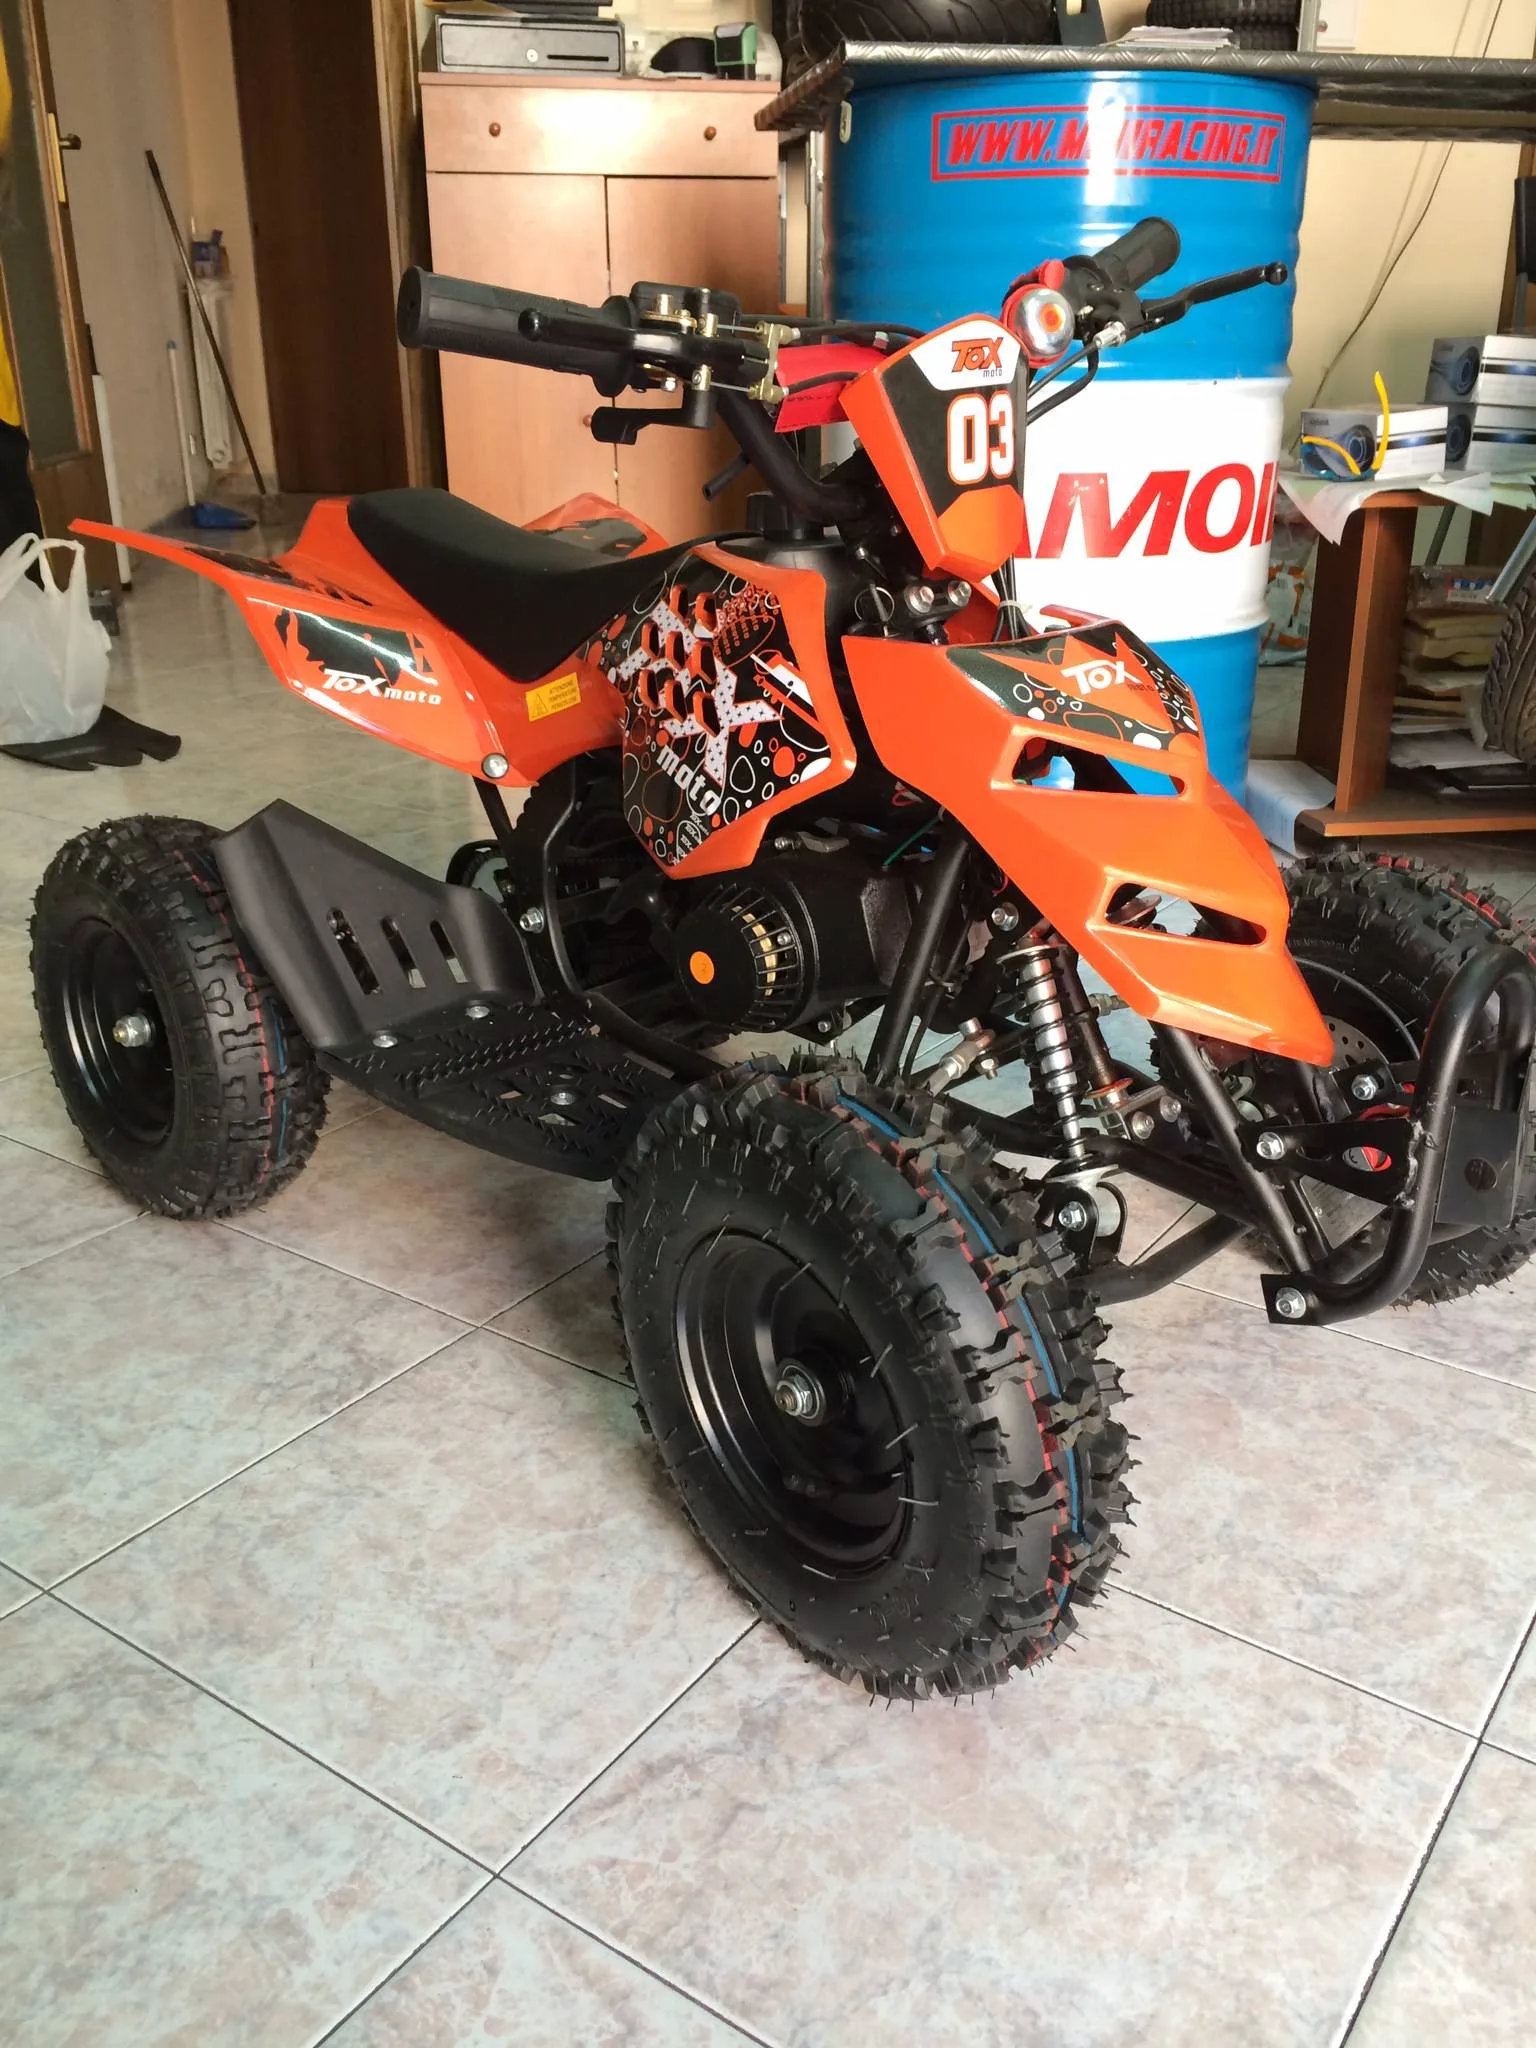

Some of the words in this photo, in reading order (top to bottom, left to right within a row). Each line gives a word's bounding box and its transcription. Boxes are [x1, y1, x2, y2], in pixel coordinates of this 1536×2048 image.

[982, 368, 1003, 379] moto
[947, 391, 1015, 486] 03
[1015, 461, 1280, 559] MOI
[384, 687, 442, 705] moto
[657, 745, 722, 816] moto
